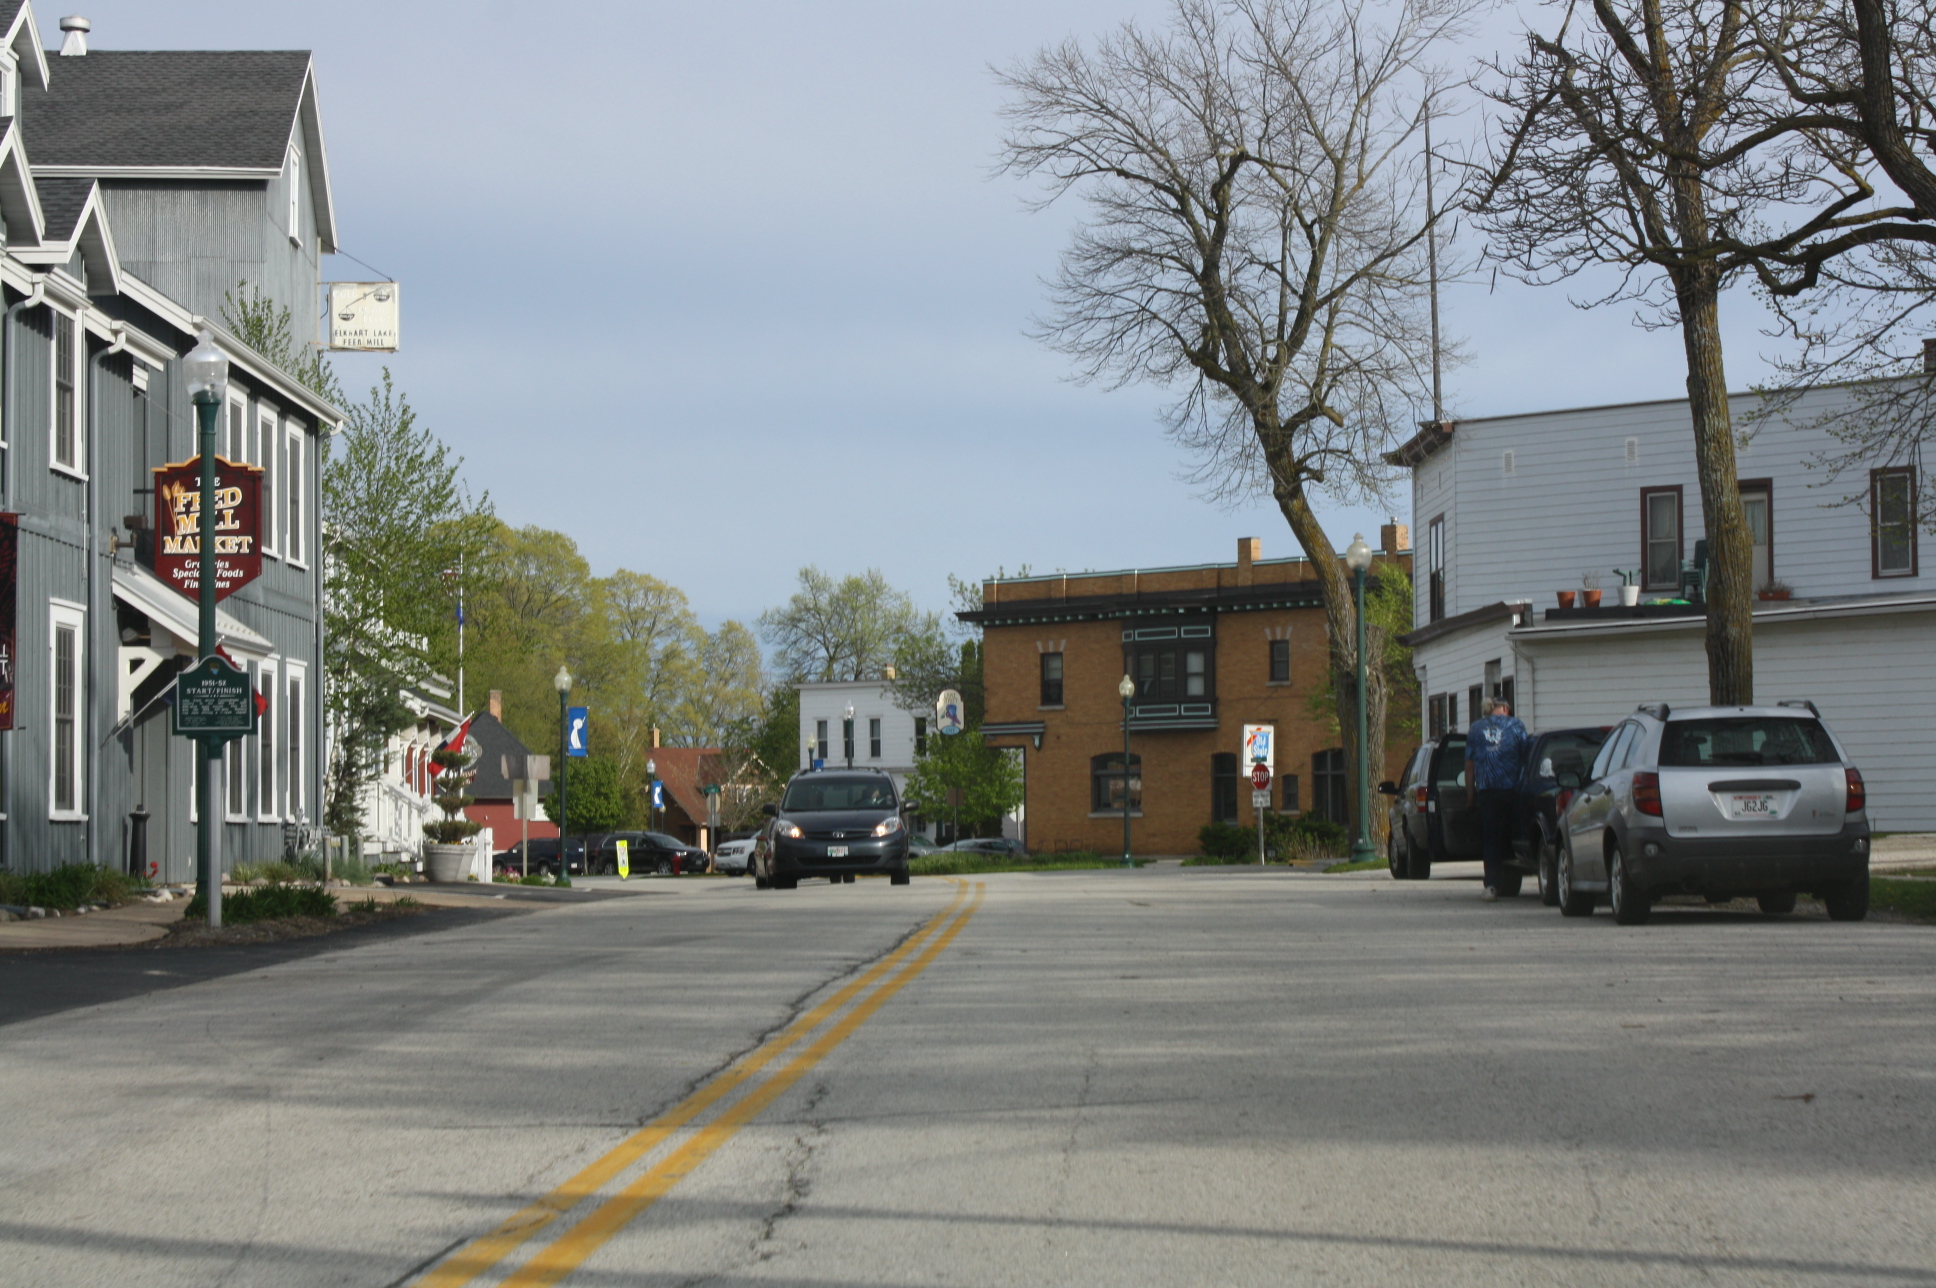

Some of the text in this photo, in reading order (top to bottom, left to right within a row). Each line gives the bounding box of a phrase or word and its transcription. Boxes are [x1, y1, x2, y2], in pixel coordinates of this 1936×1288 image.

[195, 477, 221, 487] TE
[177, 509, 240, 535] MLL
[185, 559, 229, 569] Gries
[216, 568, 244, 578] Foods
[184, 579, 203, 589] Fin
[1255, 734, 1267, 747] Old
[1253, 744, 1268, 758] Style
[1252, 771, 1269, 782] STOP
